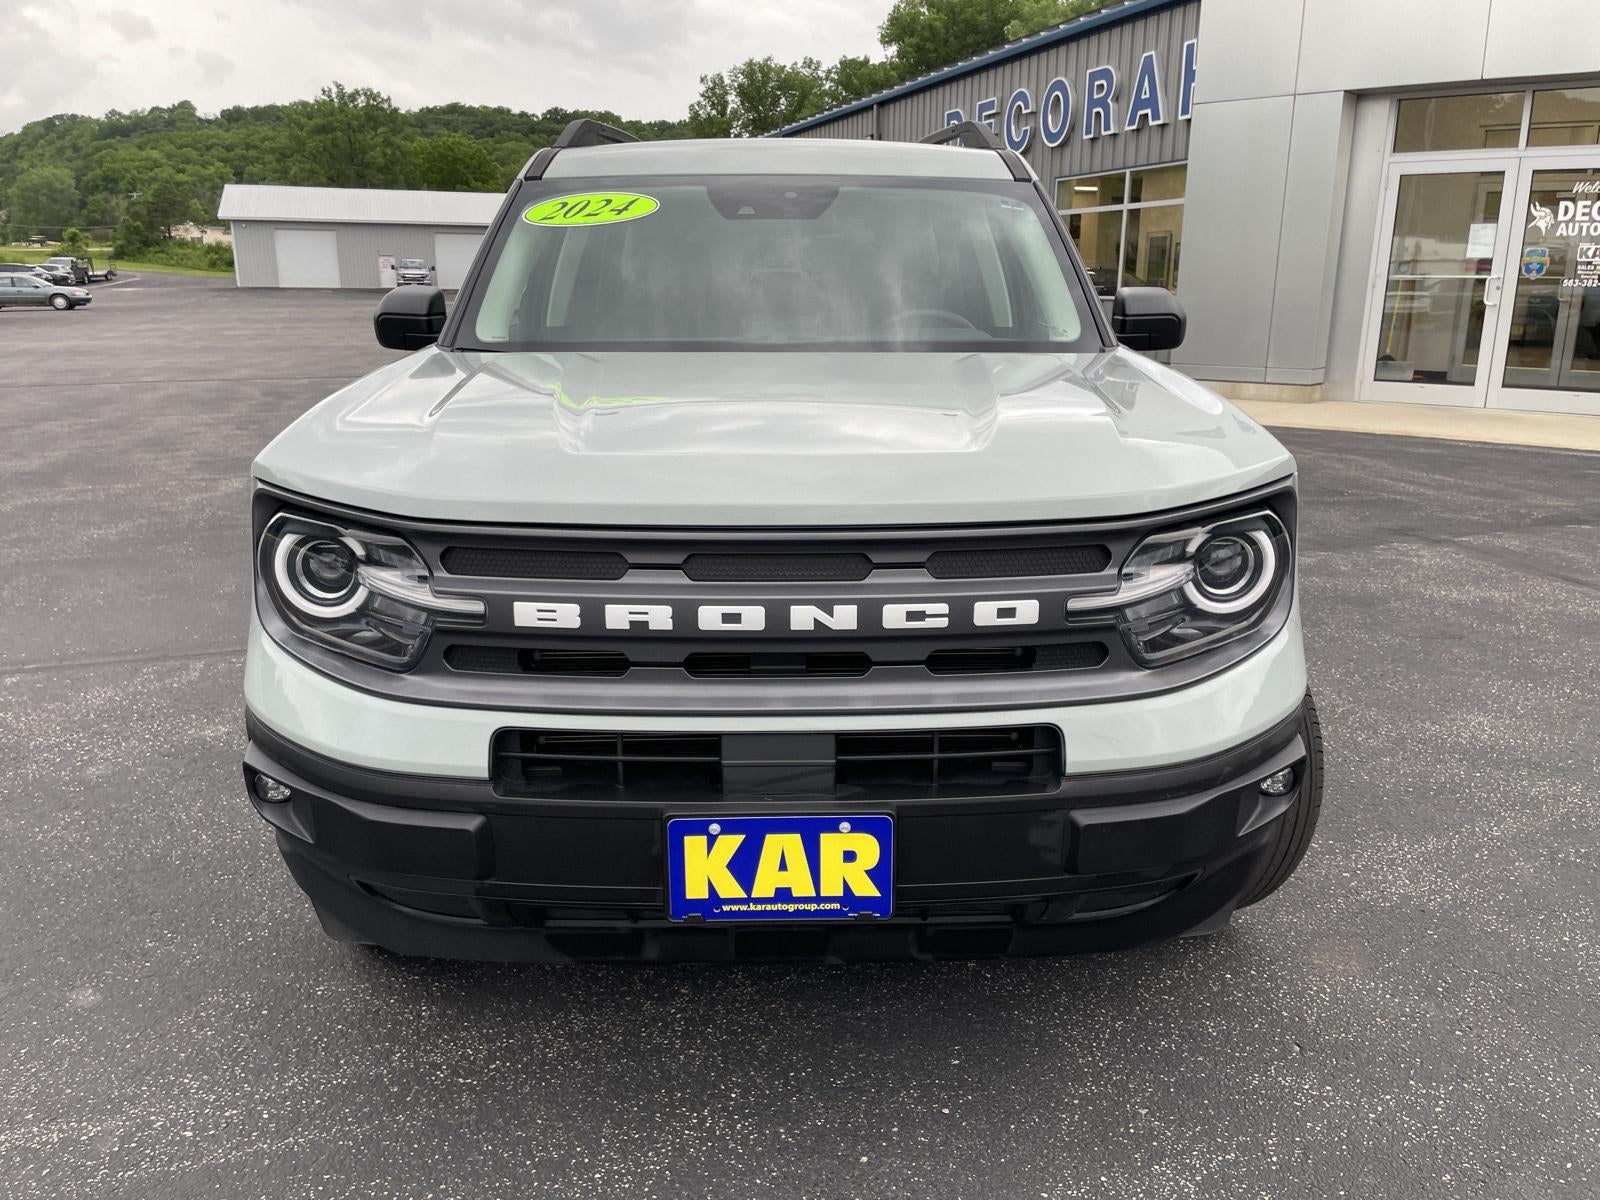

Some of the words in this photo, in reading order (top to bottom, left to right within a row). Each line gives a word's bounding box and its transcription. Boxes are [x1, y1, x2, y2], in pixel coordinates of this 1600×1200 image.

[538, 197, 640, 221] 2024
[513, 599, 1039, 631] BRONCO
[683, 832, 882, 900] KAR
[721, 902, 841, 912] www.karautogroup.com
